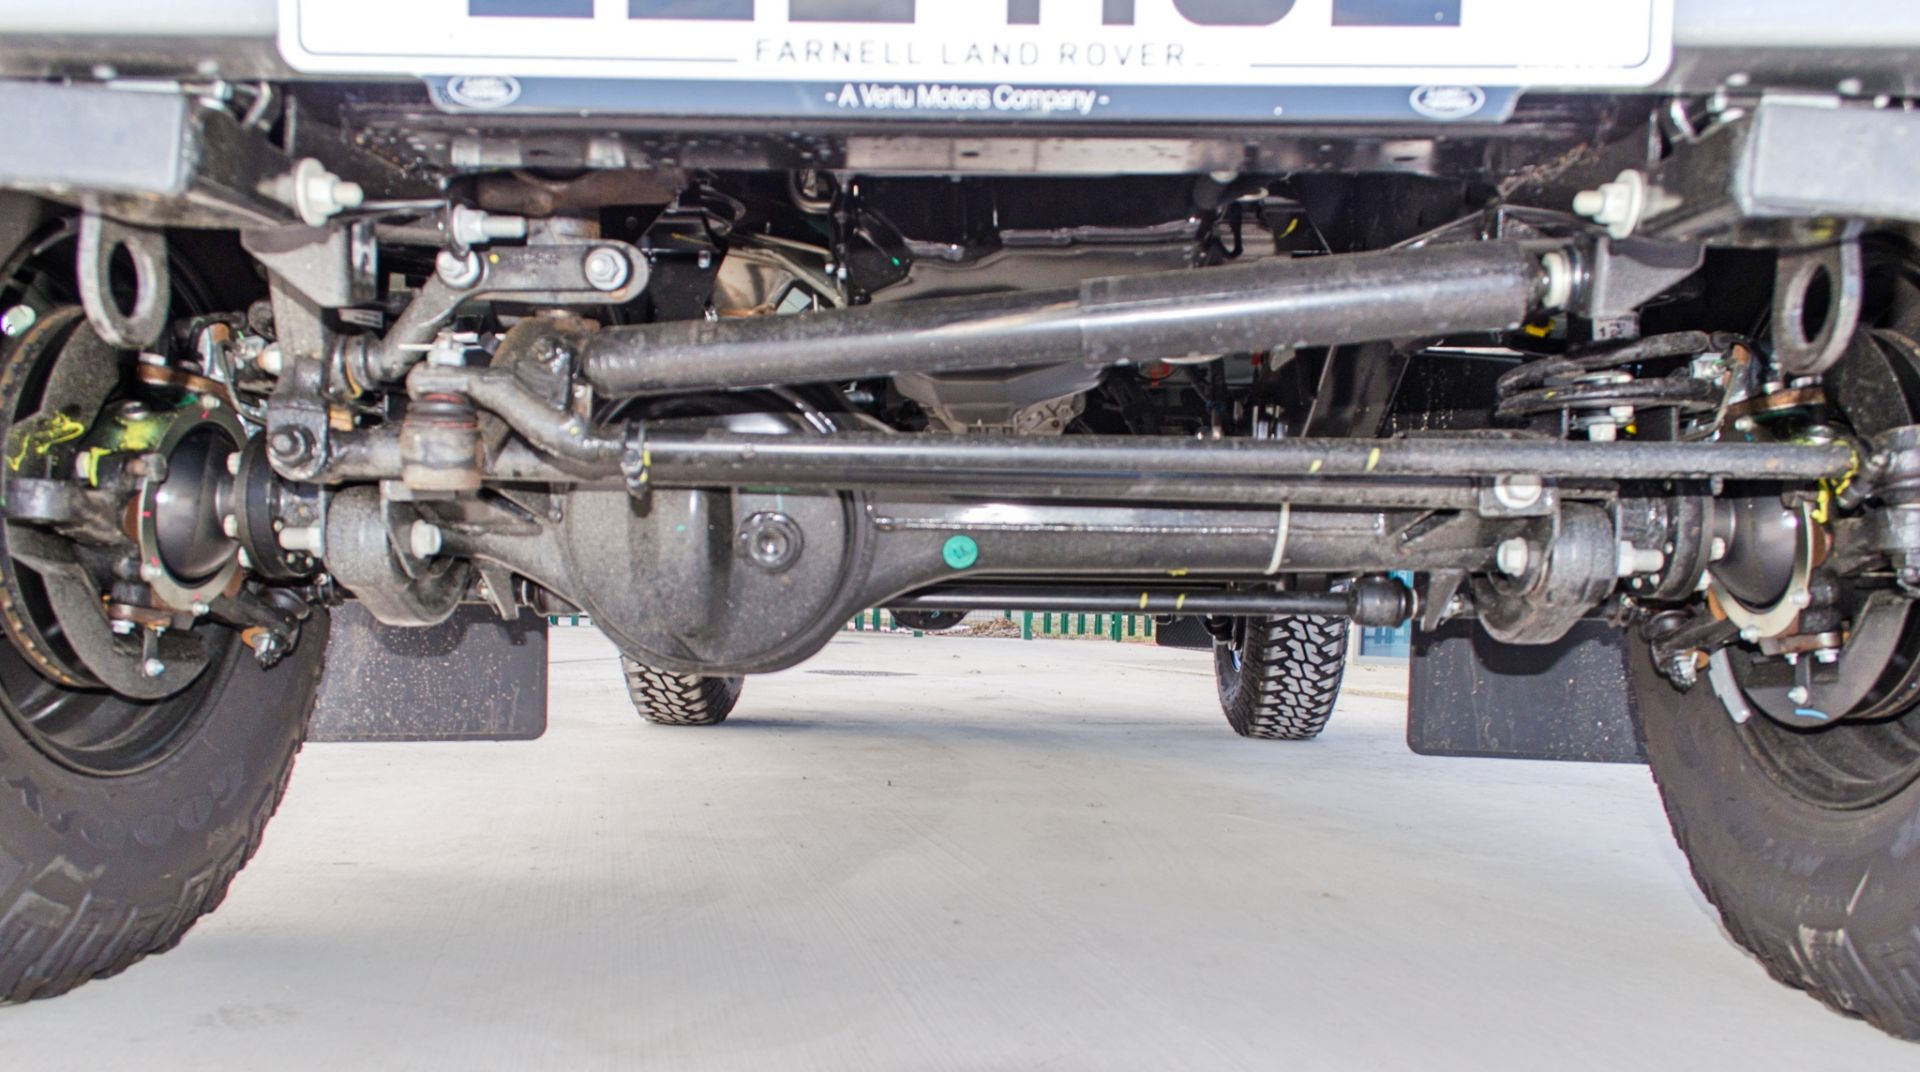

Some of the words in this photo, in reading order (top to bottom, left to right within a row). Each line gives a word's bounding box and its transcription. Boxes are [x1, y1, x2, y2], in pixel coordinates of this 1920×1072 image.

[755, 39, 922, 65] FARNELL
[942, 41, 1039, 66] LAND
[1059, 41, 1185, 66] ROVER
[860, 83, 915, 109] Vertu
[916, 83, 992, 110] Motors
[993, 84, 1096, 115] Company
